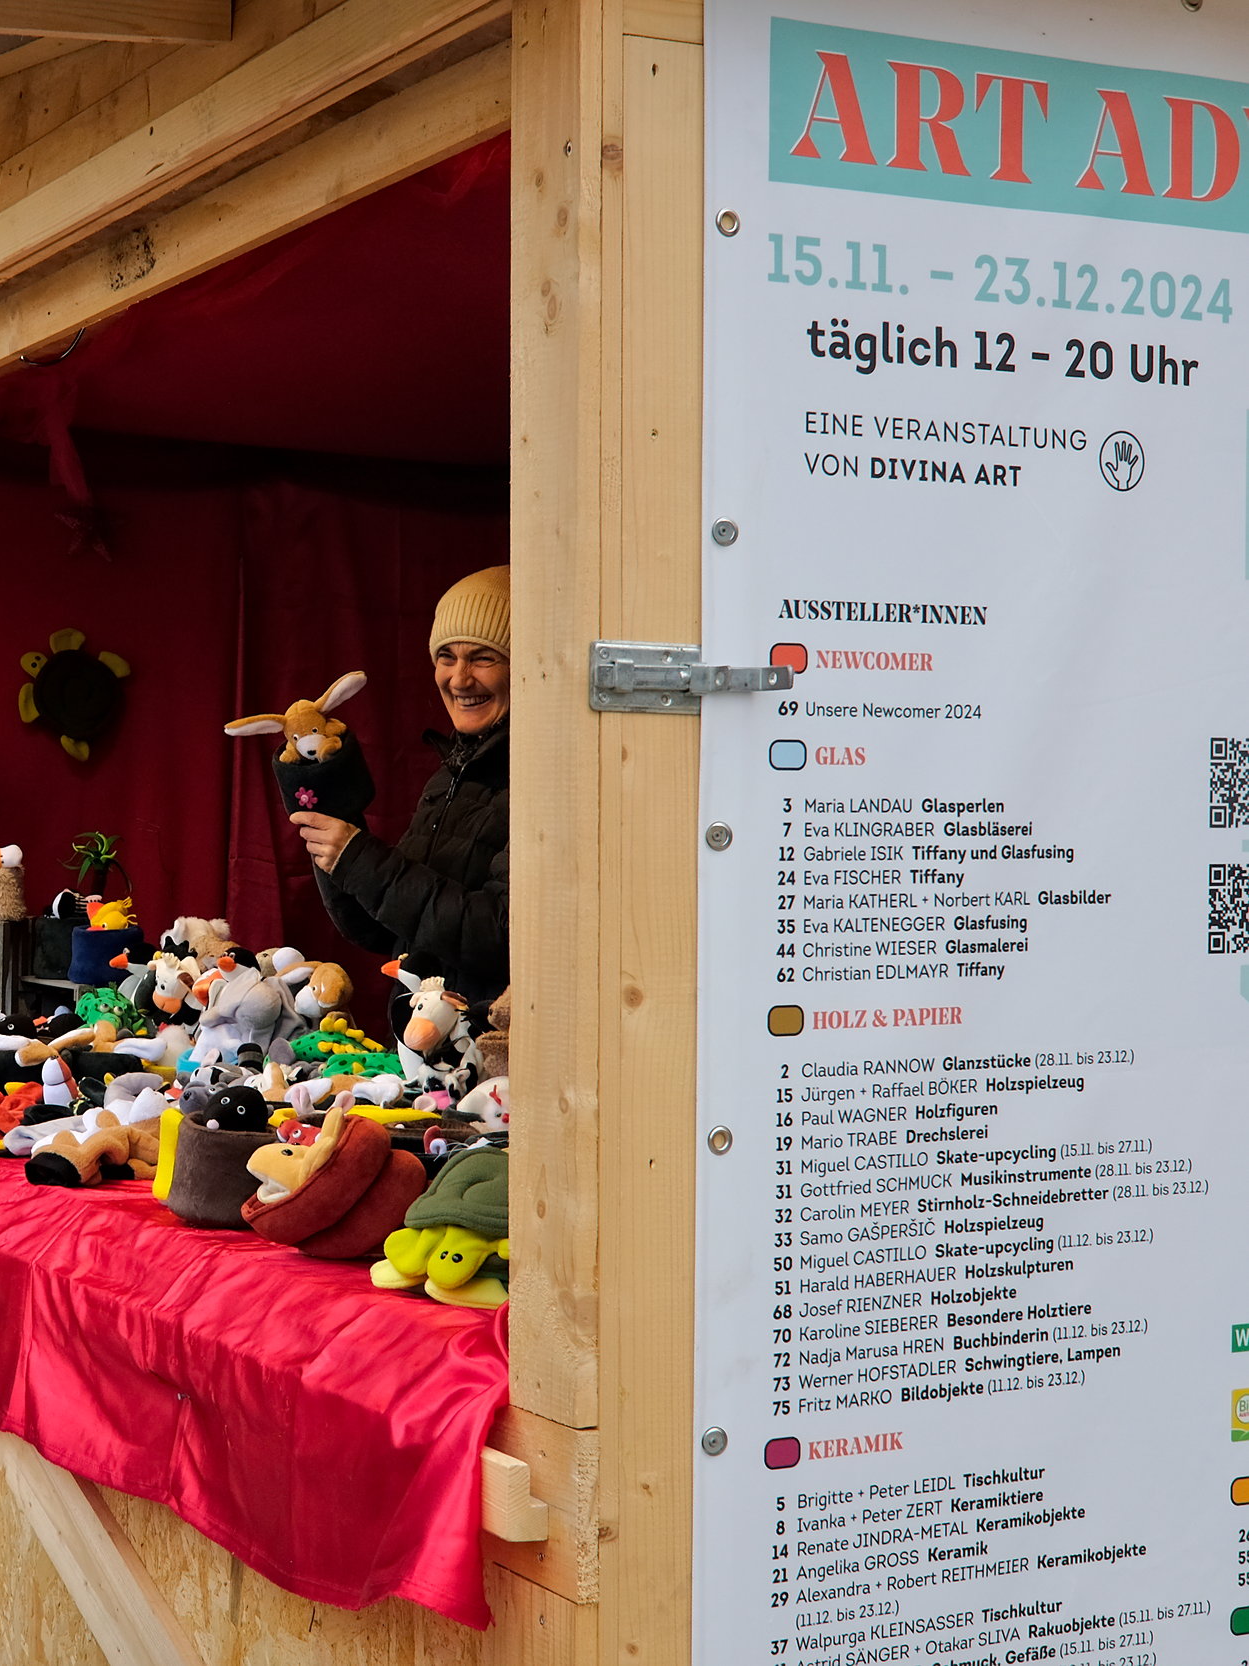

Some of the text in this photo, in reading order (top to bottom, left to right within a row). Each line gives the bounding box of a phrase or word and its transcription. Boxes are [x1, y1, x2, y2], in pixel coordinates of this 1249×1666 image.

[791, 50, 1249, 203] ART AD
[765, 232, 910, 297] 15.11.
[972, 253, 1235, 325] 23.12.2024
[806, 317, 958, 375] täglich
[974, 330, 1016, 373] 12
[1064, 338, 1114, 380] 20
[1130, 343, 1199, 387] Uhr
[805, 411, 1087, 451] EINE VERANSTALTUNG
[804, 452, 1022, 487] VON DIVINA ART
[816, 650, 933, 671] NEWCOMER
[777, 700, 982, 720] 69 Unsere Newcomer 2024
[815, 747, 866, 765] GLAS
[782, 797, 1005, 818] 3 Maria LANDAU Glasperlen
[782, 821, 1033, 838] 7 Eva KLINGRABER Glasbläserei
[778, 843, 1074, 865] 12 Gabriele ISIK Tiffany und Glasfusing
[777, 868, 965, 889] 24 Eva FISCHER Tiffany
[777, 894, 796, 910] 27
[803, 894, 844, 910] Maria
[848, 893, 918, 909] KATHERL
[934, 892, 991, 908] Norbert
[994, 891, 1031, 906] KARL
[1037, 889, 1112, 906] Glasbilder
[777, 914, 1028, 935] 35 Eva KALTENEGGER Glasfusing
[776, 937, 1029, 959] 44 Christine WIESER Glasmalerei
[776, 961, 1005, 983] 62 Christian EDLMAYR Tiffany
[813, 1006, 962, 1030] HOLZ & PAPIER
[780, 1063, 789, 1079] 2
[801, 1061, 859, 1078] Claudia
[863, 1057, 935, 1075] RANNOW
[942, 1052, 1031, 1072] Glanzstücke
[1076, 1051, 1094, 1065] bis
[776, 1087, 793, 1104] 15
[800, 1086, 855, 1106] Jürgen
[872, 1081, 925, 1099] Raffael
[928, 1077, 978, 1096] BÖKER
[986, 1074, 1085, 1095] Holzspielzeug
[775, 1102, 998, 1128] 16 Paul WAGNER Holzfiguren
[775, 1124, 989, 1152] 19 Mario TRABE Drechslerei
[775, 1160, 793, 1176] 31
[801, 1156, 850, 1178] Miguel
[854, 1151, 929, 1171] CASTILLO
[936, 1144, 1057, 1166] Skate-upcycling
[1097, 1141, 1115, 1155] bis
[774, 1207, 793, 1224] 32
[800, 1204, 856, 1222] Carolin
[860, 1199, 910, 1218] MEYER
[917, 1187, 1110, 1213] Stirnholz-Schneidebretter
[1152, 1183, 1170, 1197] bis
[774, 1215, 1044, 1248] 33 Samo GAŠPERŠIČ Holzspielzeug
[774, 1259, 1074, 1296] 51 Harald HABERHAUER Holzskulpturen
[772, 1285, 1017, 1320] 68 Josef RIENZNER Holzobjekte
[772, 1302, 1092, 1345] 70 Karoline SIEBERER Besondere Holztiere
[772, 1346, 1121, 1393] 73 Werner HOFSTADLER Schwingtiere, Lampen
[809, 1431, 903, 1460] KERAMIK
[776, 1496, 786, 1512] 5
[797, 1490, 854, 1512] Brigitte
[869, 1484, 910, 1500] Peter
[914, 1475, 956, 1495] LEIDL
[962, 1466, 1046, 1488] Tischkultur
[772, 1505, 1086, 1561] 14 Renate JINDRA-METAL Keramikobjekte
[770, 1591, 789, 1608] 29
[795, 1581, 871, 1605] Alexandra
[887, 1572, 937, 1591] Robert
[941, 1557, 1029, 1584] REITHMEIER
[1037, 1543, 1147, 1570] Keramikobjekte
[772, 1540, 988, 1584] 21 Angelika GROSS Keramik
[770, 1600, 1063, 1656] 37 Walpurga KLEINSASSER Tischkultur
